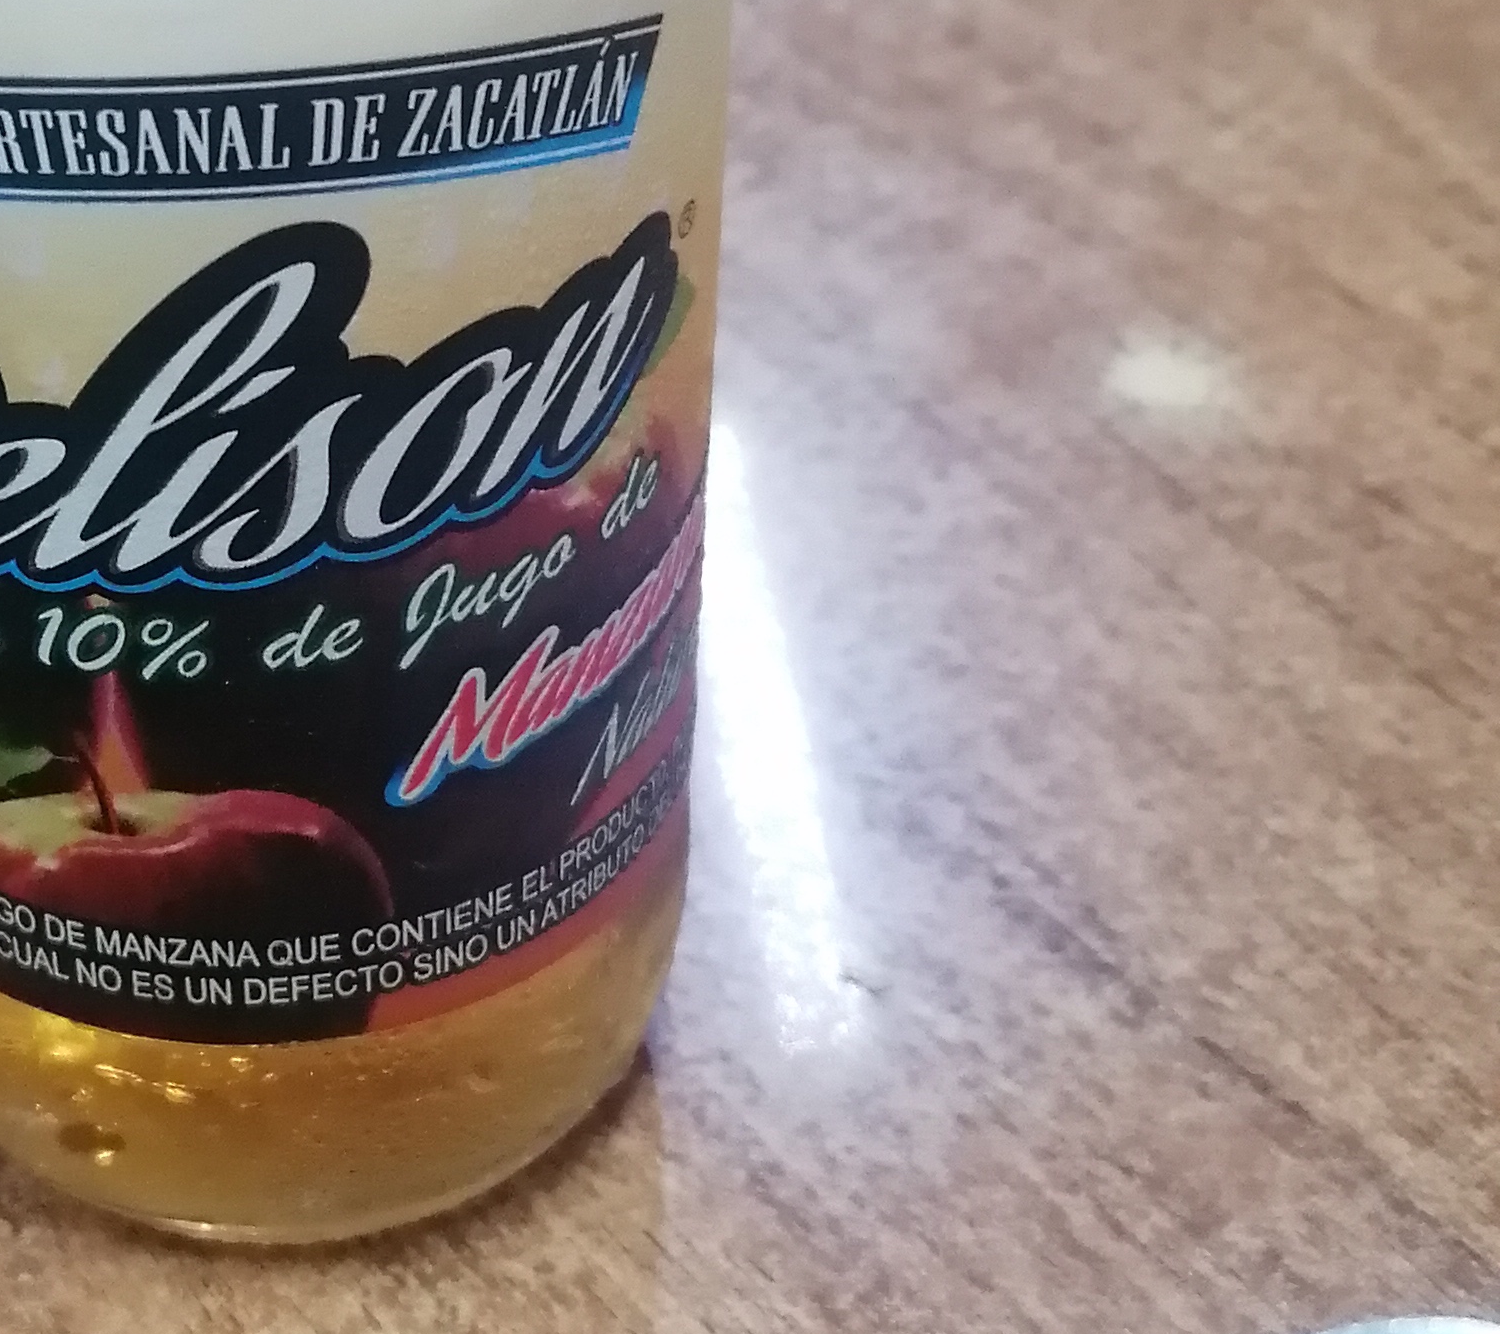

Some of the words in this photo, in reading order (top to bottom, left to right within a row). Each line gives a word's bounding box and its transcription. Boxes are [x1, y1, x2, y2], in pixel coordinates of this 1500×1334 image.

[306, 92, 386, 167] DE
[396, 39, 640, 159] ZACATLÁN
[35, 606, 211, 682] 10%
[261, 603, 366, 671] de
[399, 533, 577, 670] Jugo
[601, 454, 658, 540] de
[44, 912, 88, 951] DE
[94, 925, 261, 968] MANZANA
[266, 932, 342, 967] QUE
[350, 882, 513, 957] CONTIENE
[521, 864, 554, 903] EL
[75, 956, 123, 993] NO
[131, 969, 176, 1001] ES
[185, 975, 233, 1006] UN
[243, 960, 404, 1006] DEFECTO
[413, 932, 489, 982] SINO
[496, 909, 535, 951] UN
[541, 823, 645, 929] ATRIBUTO
